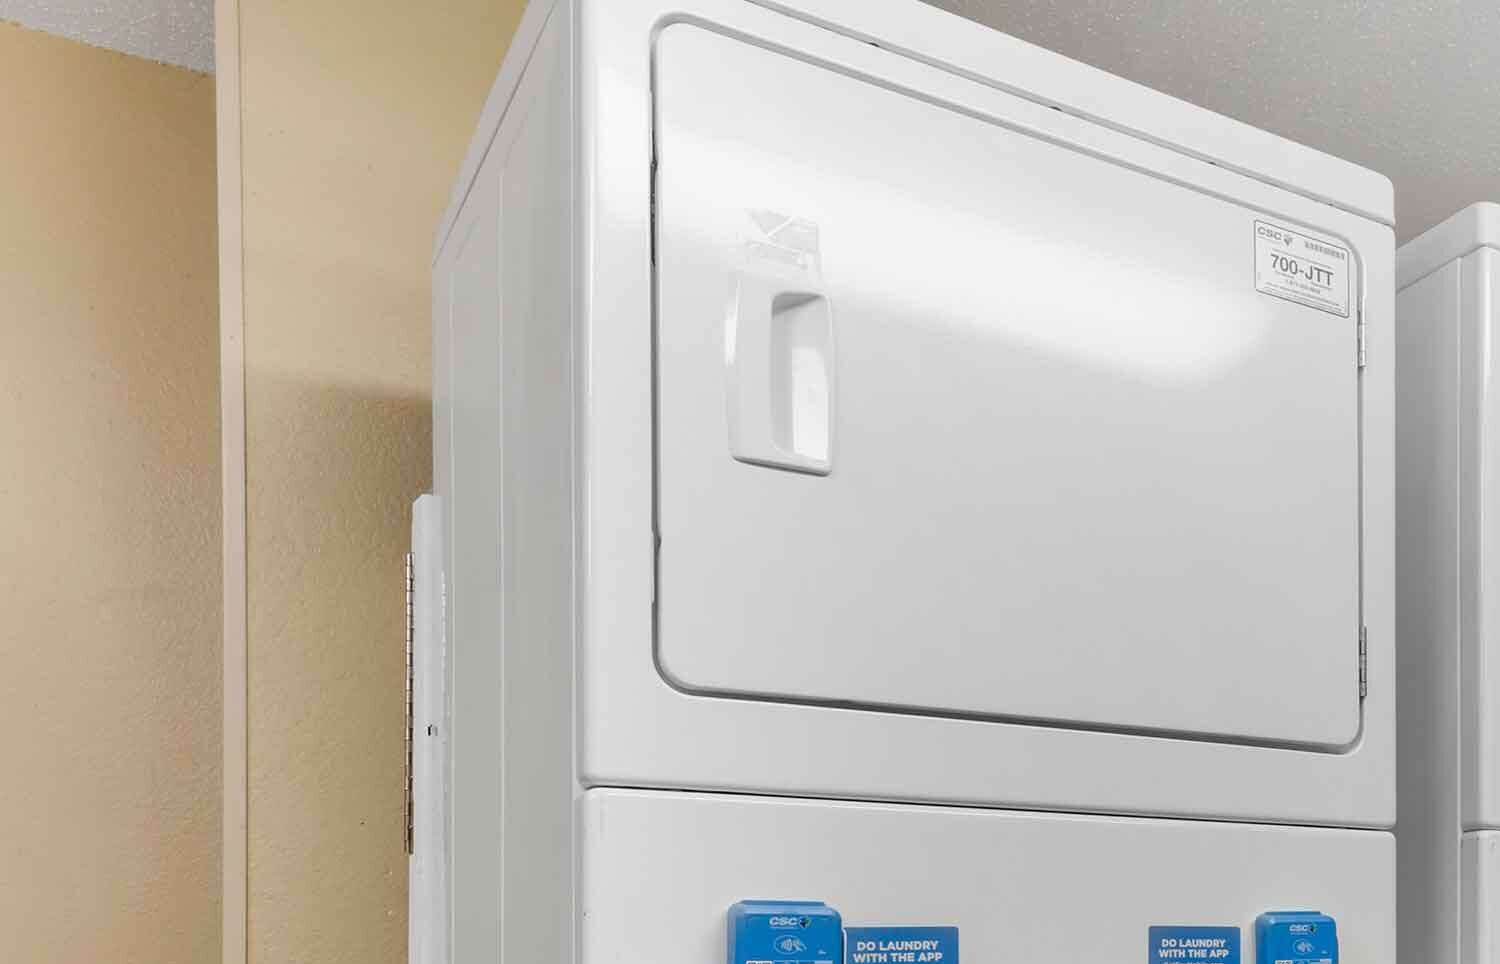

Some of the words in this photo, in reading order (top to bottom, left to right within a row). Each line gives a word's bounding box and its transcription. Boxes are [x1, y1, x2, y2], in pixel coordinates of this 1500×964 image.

[1257, 226, 1282, 240] CSC
[1270, 253, 1334, 286] 700-JTT
[769, 917, 798, 927] CSC
[857, 941, 877, 951] DO
[879, 940, 939, 951] LAUNDRY
[1161, 939, 1177, 948] DO
[1179, 939, 1226, 948] LAUNDRY
[853, 952, 890, 963] WITH
[891, 952, 916, 962] THE
[919, 952, 943, 962] APP
[1158, 950, 1188, 958] WITH
[1189, 950, 1208, 958] THE
[1210, 950, 1229, 958] APP
